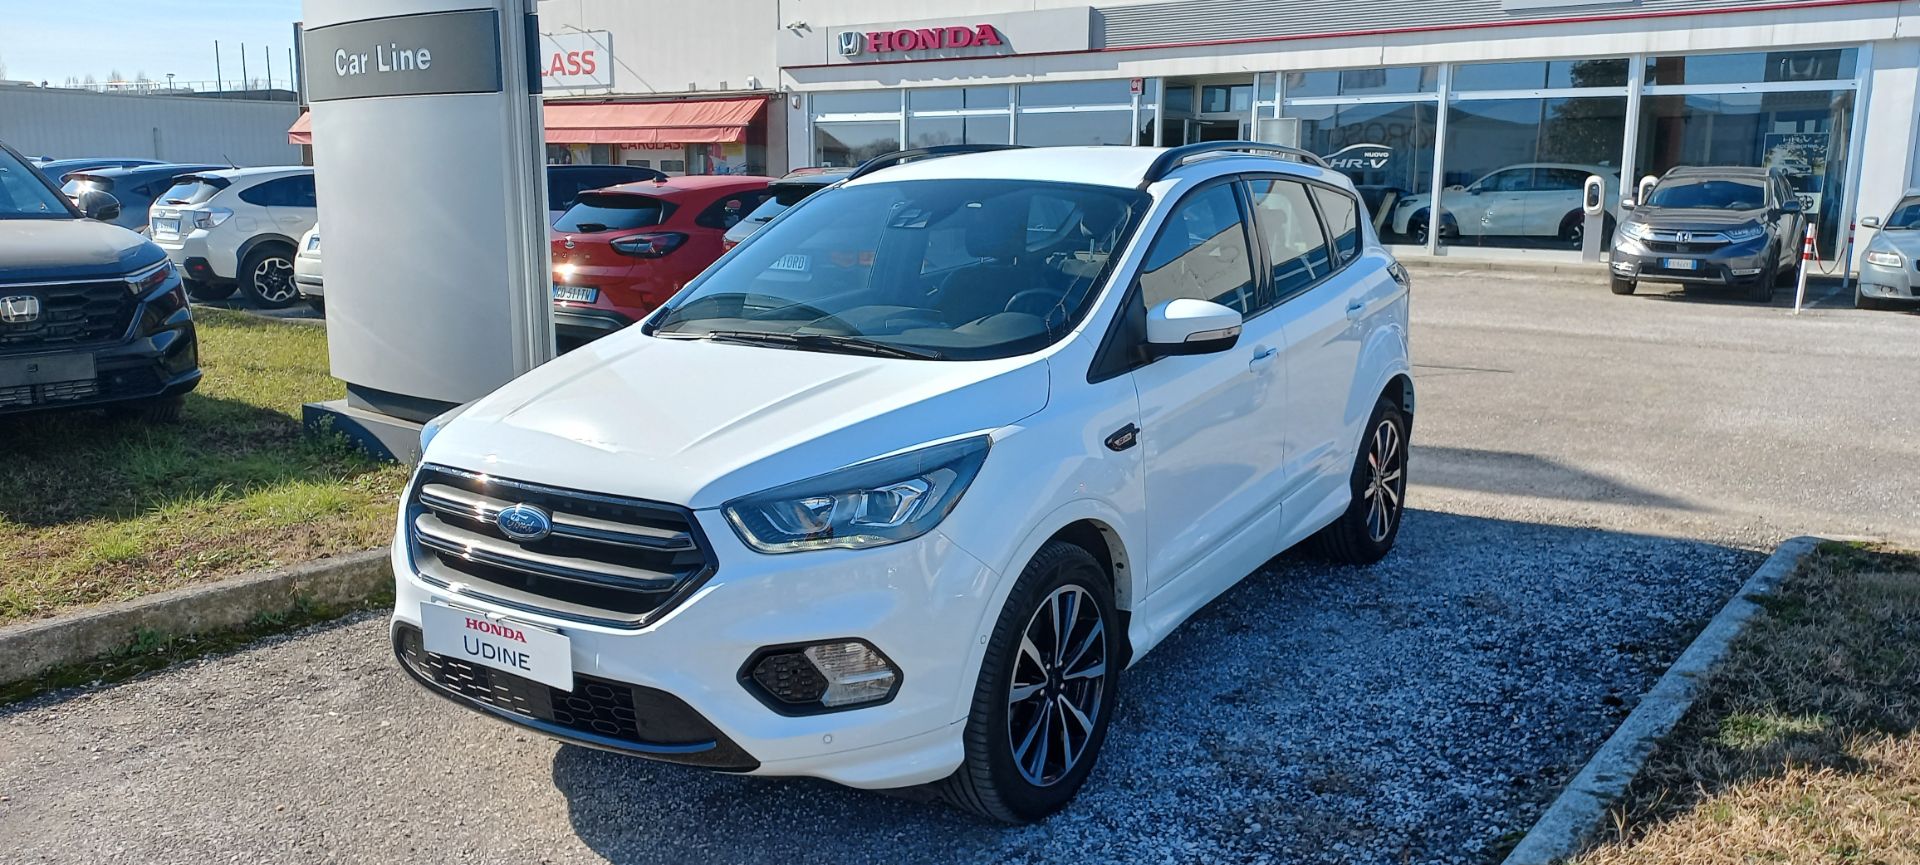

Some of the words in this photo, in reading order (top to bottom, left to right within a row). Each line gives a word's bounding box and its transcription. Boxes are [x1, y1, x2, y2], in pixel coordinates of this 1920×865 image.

[866, 24, 1001, 53] HONDA
[335, 48, 368, 76] Car
[376, 43, 432, 72] Line
[1330, 158, 1388, 169] HR-V
[507, 512, 535, 532] Ford
[465, 617, 527, 643] HONDA
[464, 635, 531, 671] UDINE
